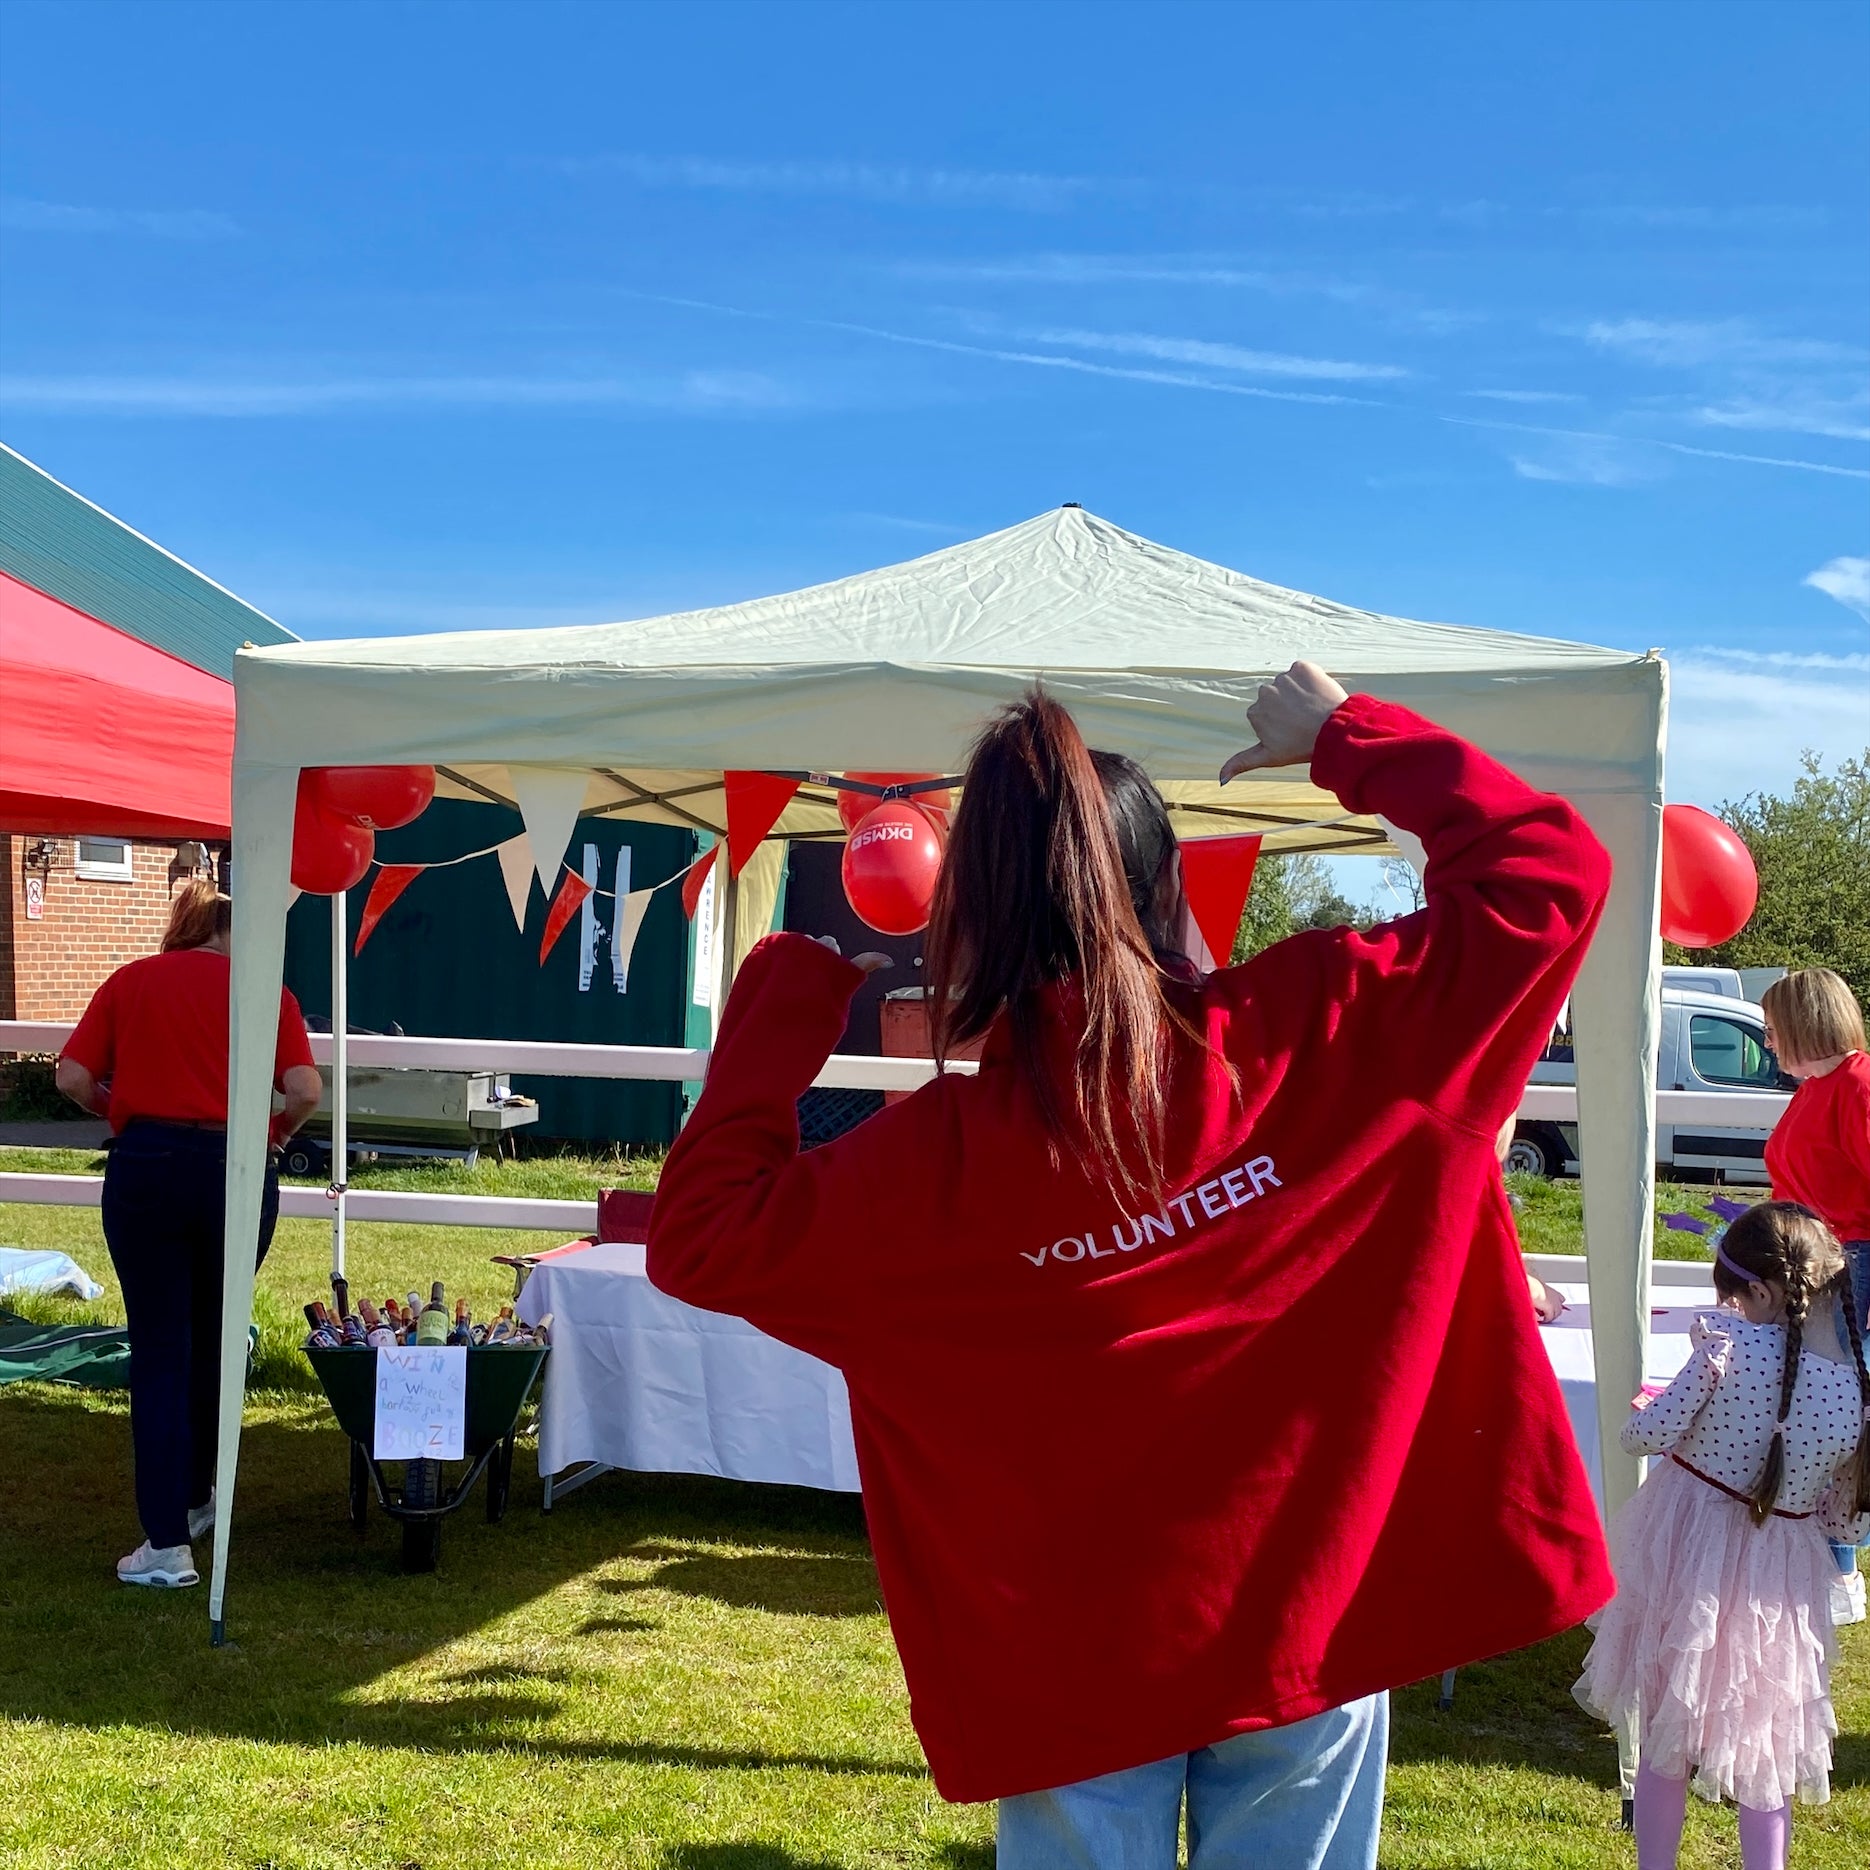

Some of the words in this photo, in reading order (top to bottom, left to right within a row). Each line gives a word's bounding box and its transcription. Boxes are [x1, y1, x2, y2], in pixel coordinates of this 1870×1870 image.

[862, 827, 914, 846] DKMS
[703, 870, 712, 956] AWRENCE
[1019, 1155, 1283, 1267] VOLUNTEER
[383, 1348, 446, 1374] WIN
[382, 1421, 459, 1452] BOOZE
